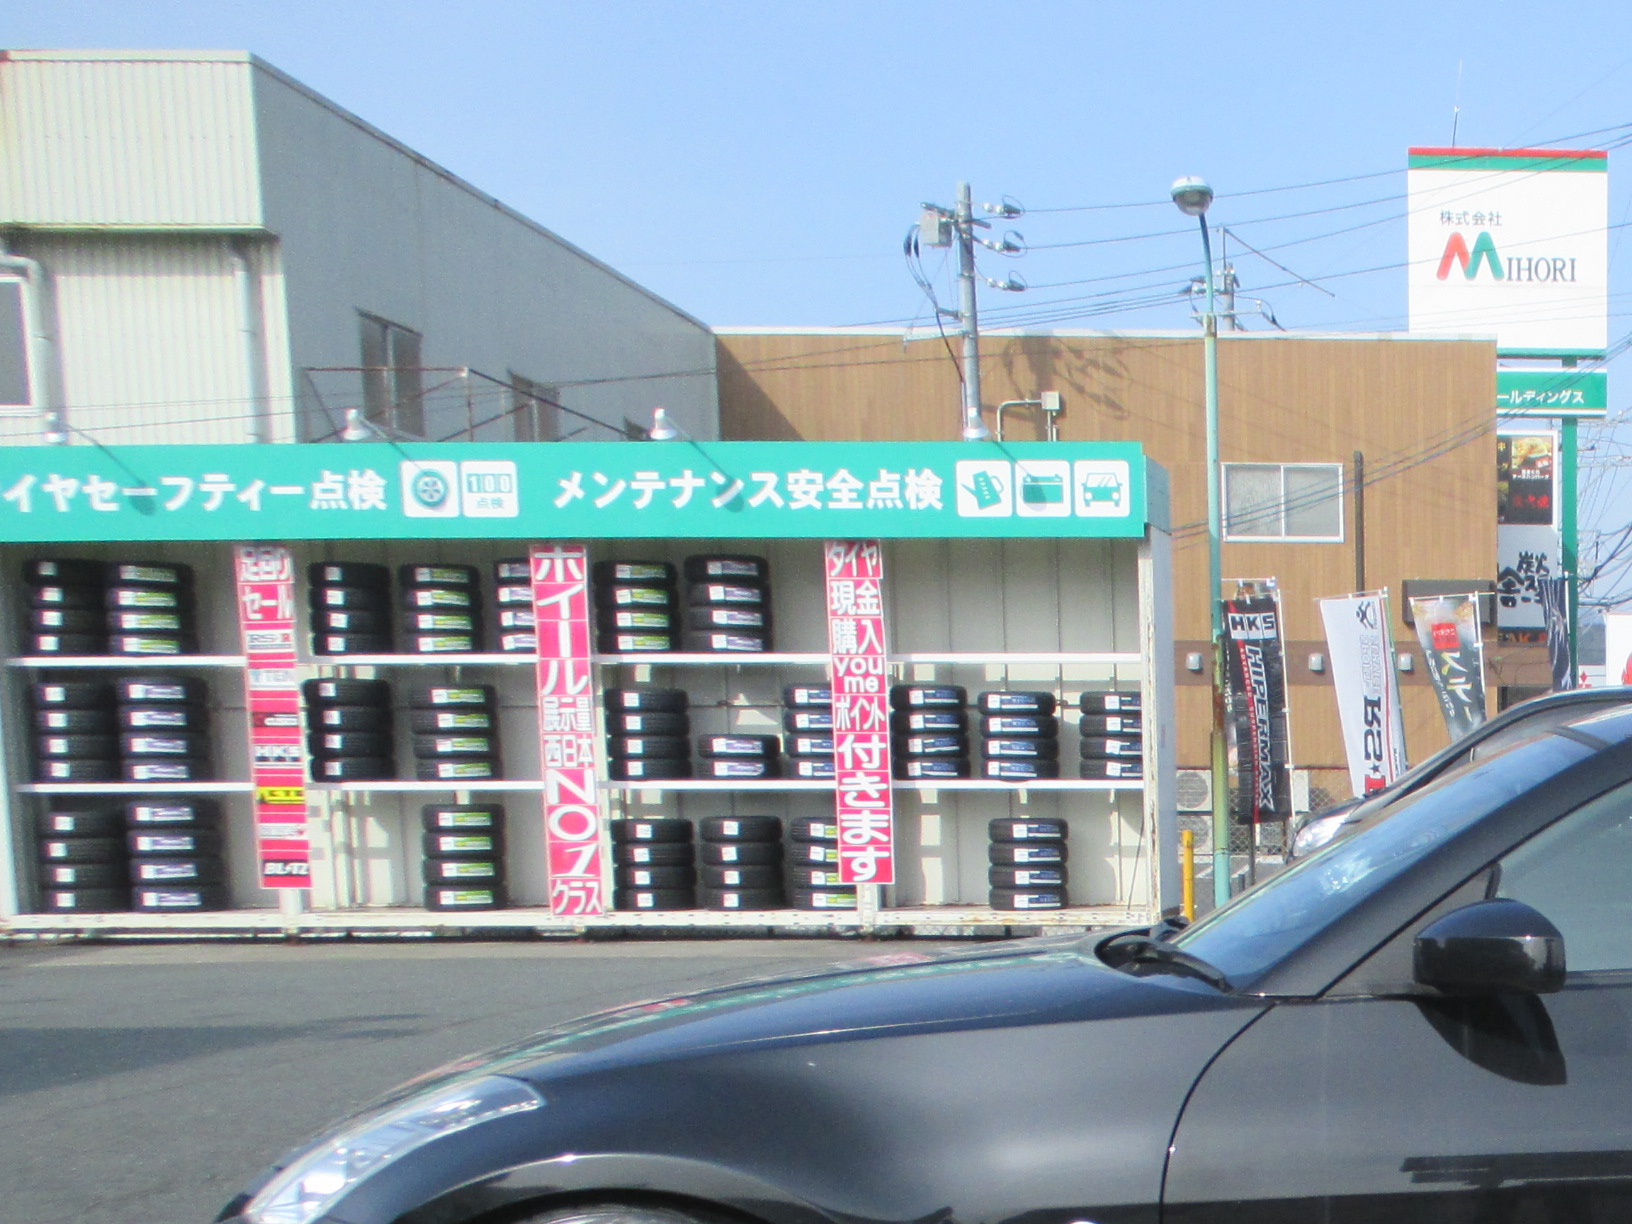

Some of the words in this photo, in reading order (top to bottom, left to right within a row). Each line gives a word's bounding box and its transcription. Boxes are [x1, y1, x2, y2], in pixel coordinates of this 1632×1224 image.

[1439, 209, 1503, 226] 株式会社
[1436, 231, 1577, 282] MIHORI
[3, 468, 388, 512] イヤセーフティー点検
[467, 473, 513, 493] 100
[554, 468, 944, 510] メンテナンス安全点検
[1230, 614, 1276, 634] HKS
[833, 657, 884, 677] you
[843, 676, 880, 693] me
[836, 696, 887, 731] ポイント
[1246, 644, 1276, 812] HIPERMAX
[544, 734, 595, 767] 西日本
[837, 733, 891, 882] 付きます
[552, 879, 603, 915] クラス
